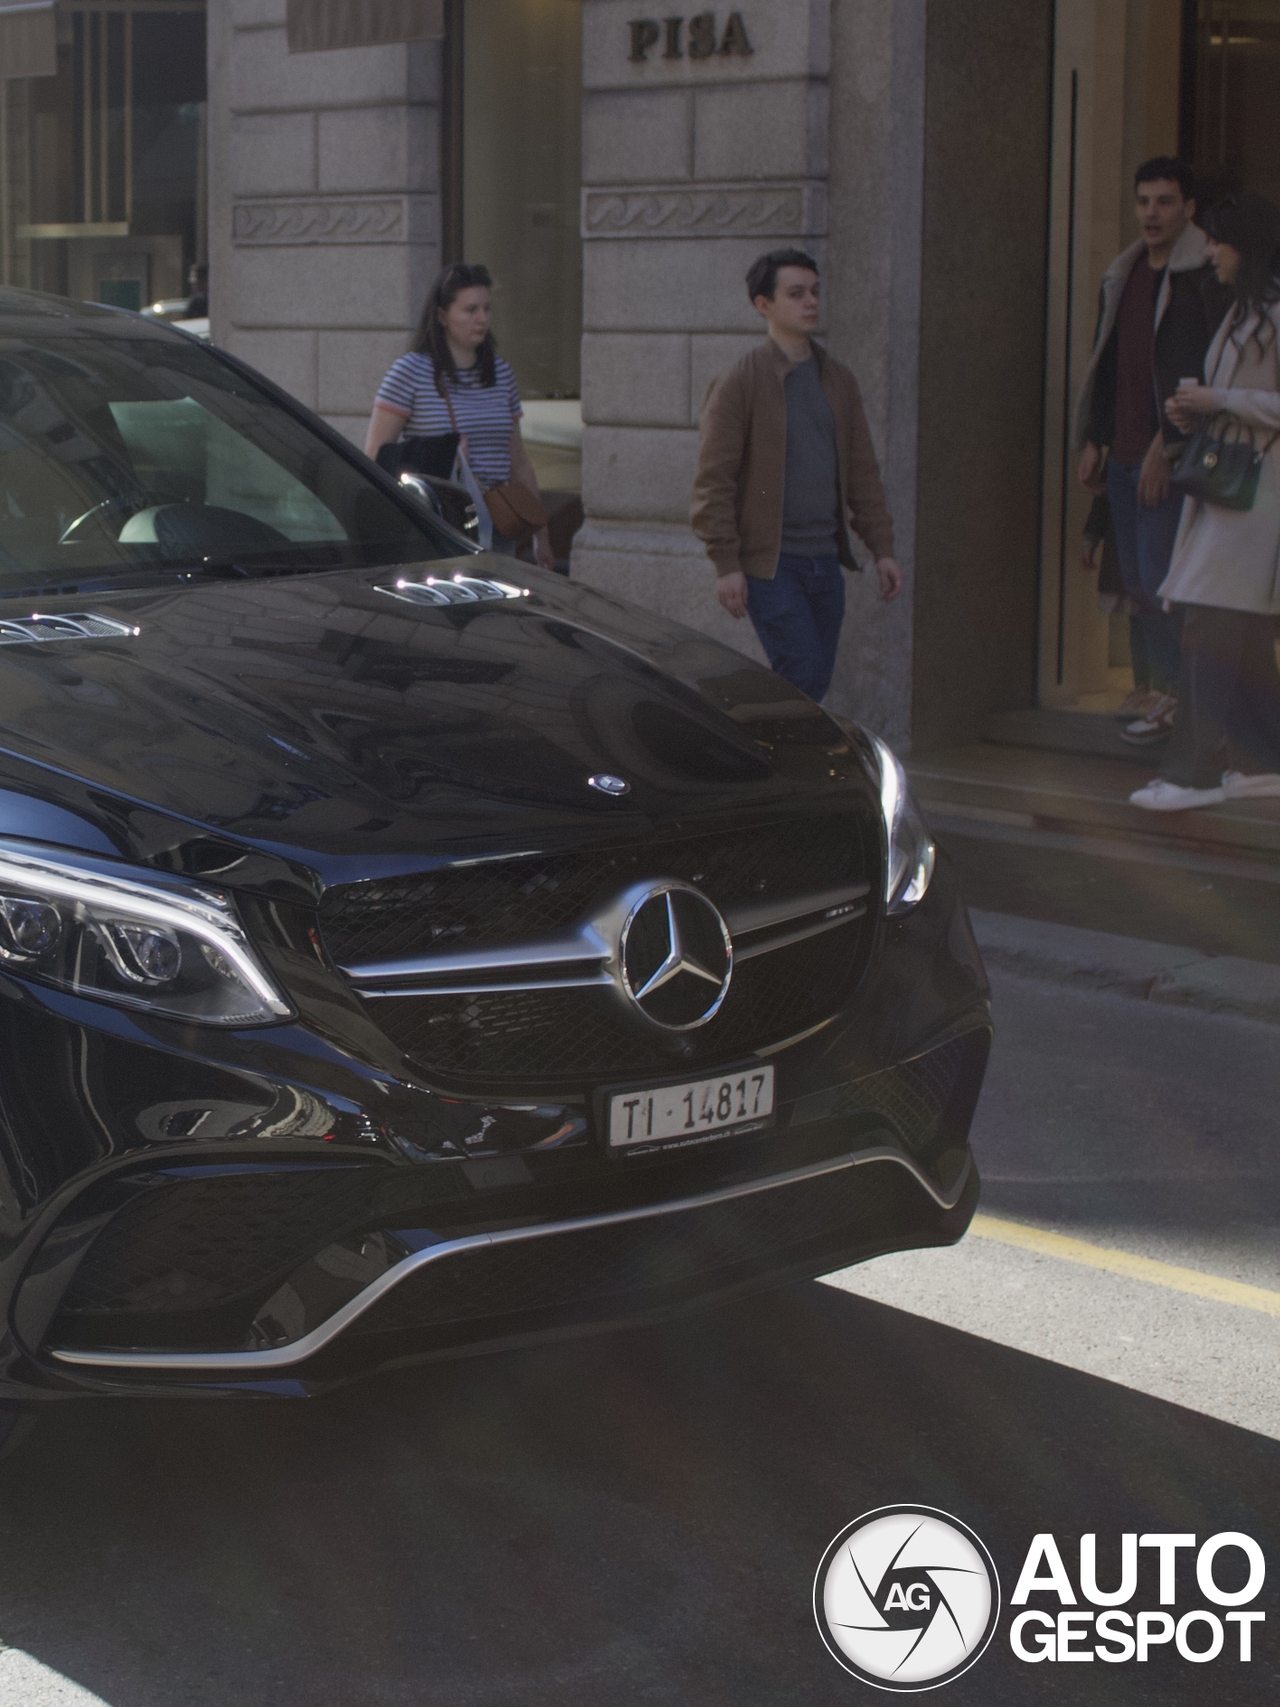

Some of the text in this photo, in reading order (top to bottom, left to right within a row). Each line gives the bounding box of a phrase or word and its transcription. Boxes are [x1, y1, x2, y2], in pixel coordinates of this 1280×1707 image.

[627, 12, 755, 60] PISA
[623, 1073, 765, 1139] TI 14817
